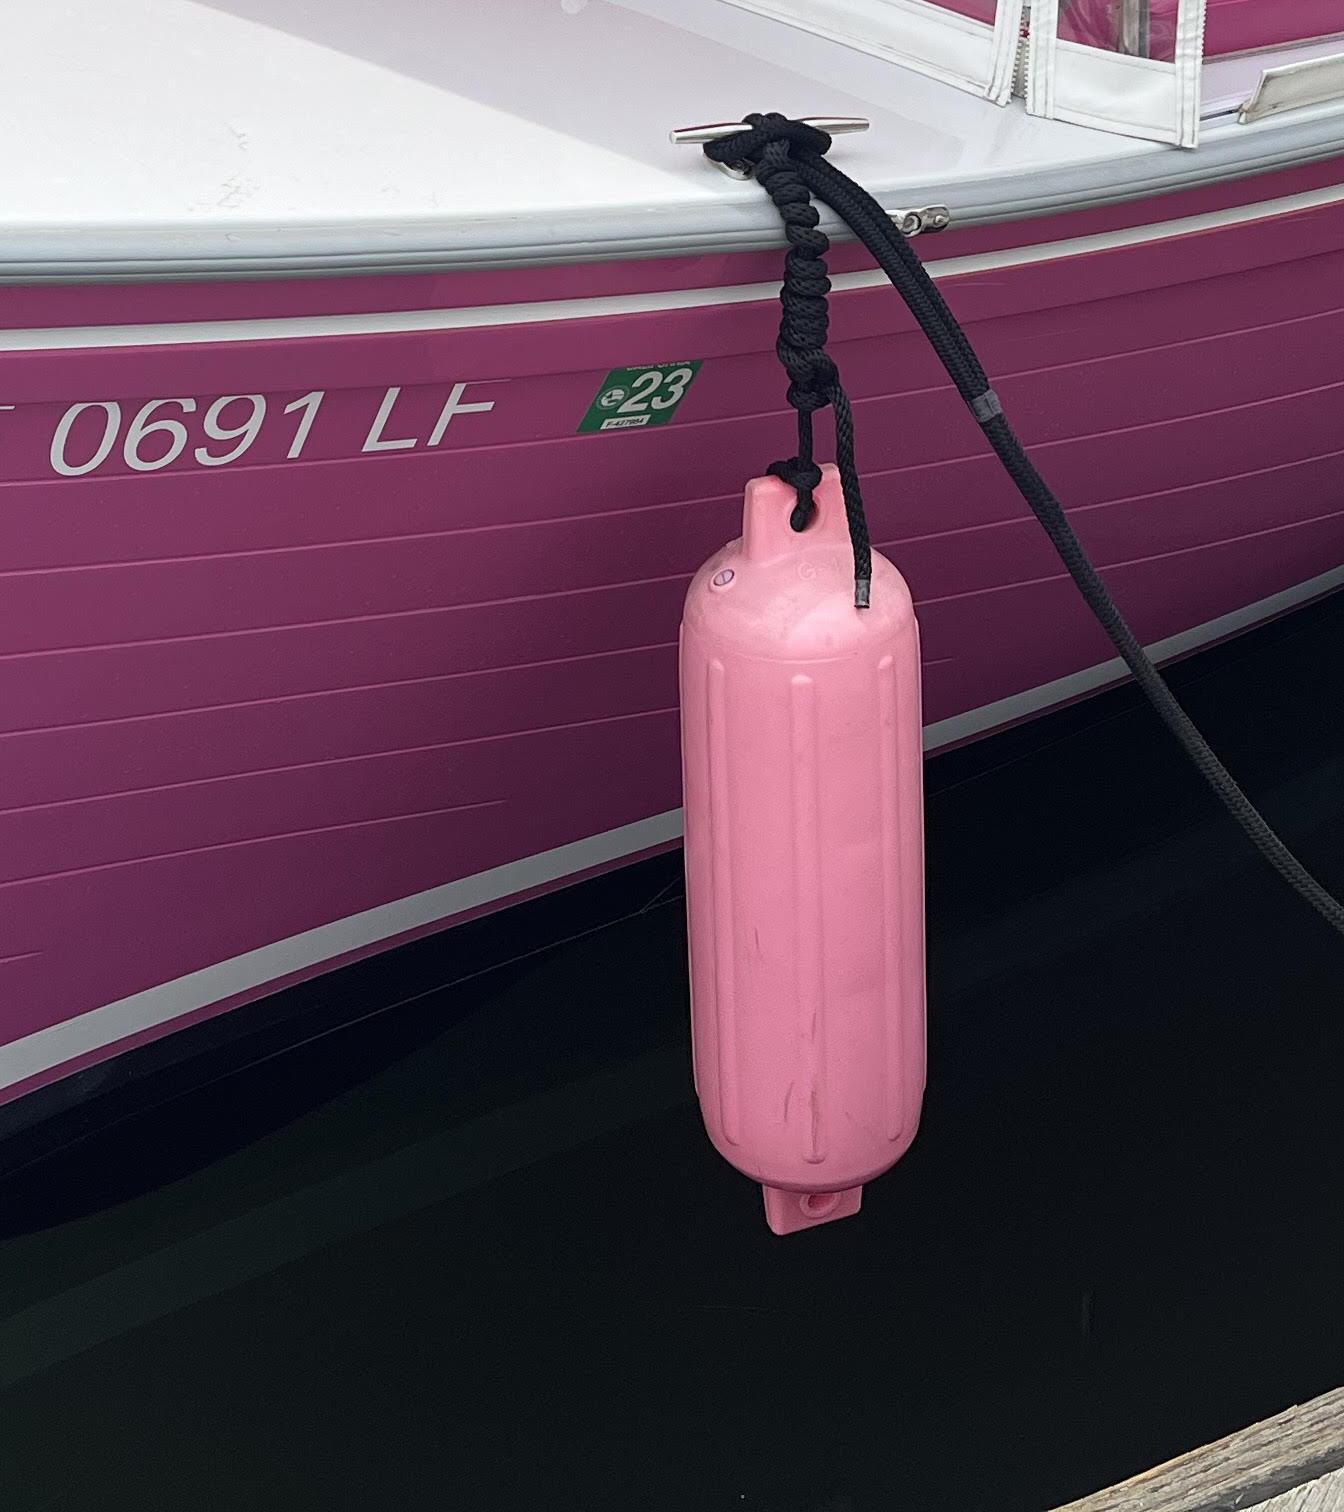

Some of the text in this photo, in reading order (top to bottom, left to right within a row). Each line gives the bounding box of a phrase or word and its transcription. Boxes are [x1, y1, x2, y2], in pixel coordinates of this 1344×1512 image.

[616, 368, 693, 413] 23
[50, 391, 325, 476] 0691
[362, 379, 511, 452] LF
